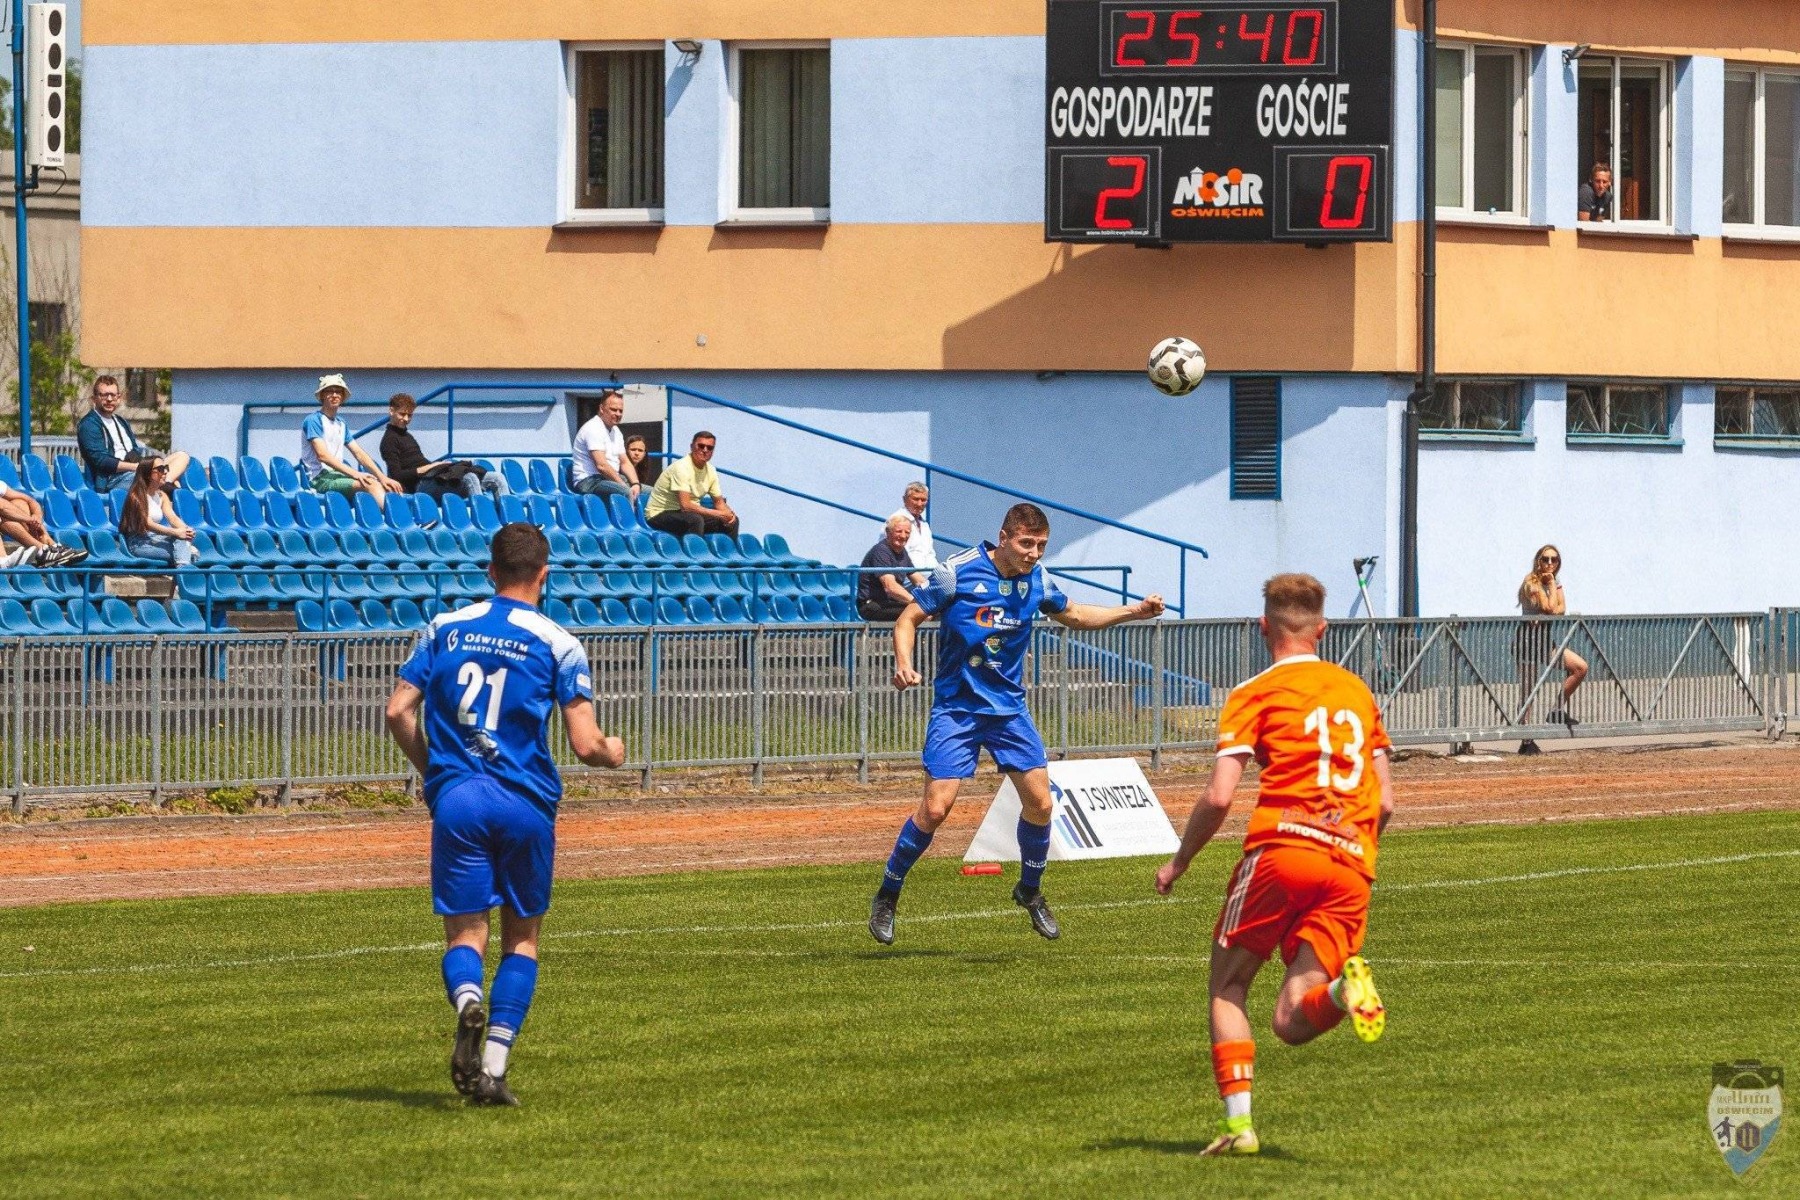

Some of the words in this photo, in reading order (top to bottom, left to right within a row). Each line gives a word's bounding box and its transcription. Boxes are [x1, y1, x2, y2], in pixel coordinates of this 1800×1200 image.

[1116, 10, 1323, 67] 25:40
[1050, 86, 1213, 138] GOSPODARZE
[1256, 78, 1350, 138] GOŚCIE
[1094, 156, 1146, 229] 2
[1170, 206, 1264, 218] OŚWIĘCIM
[1319, 156, 1373, 229] 0
[461, 644, 492, 653] MIASTO
[464, 633, 529, 652] OŚWIĘCIM
[457, 661, 508, 731] 21
[1304, 706, 1364, 791] 13
